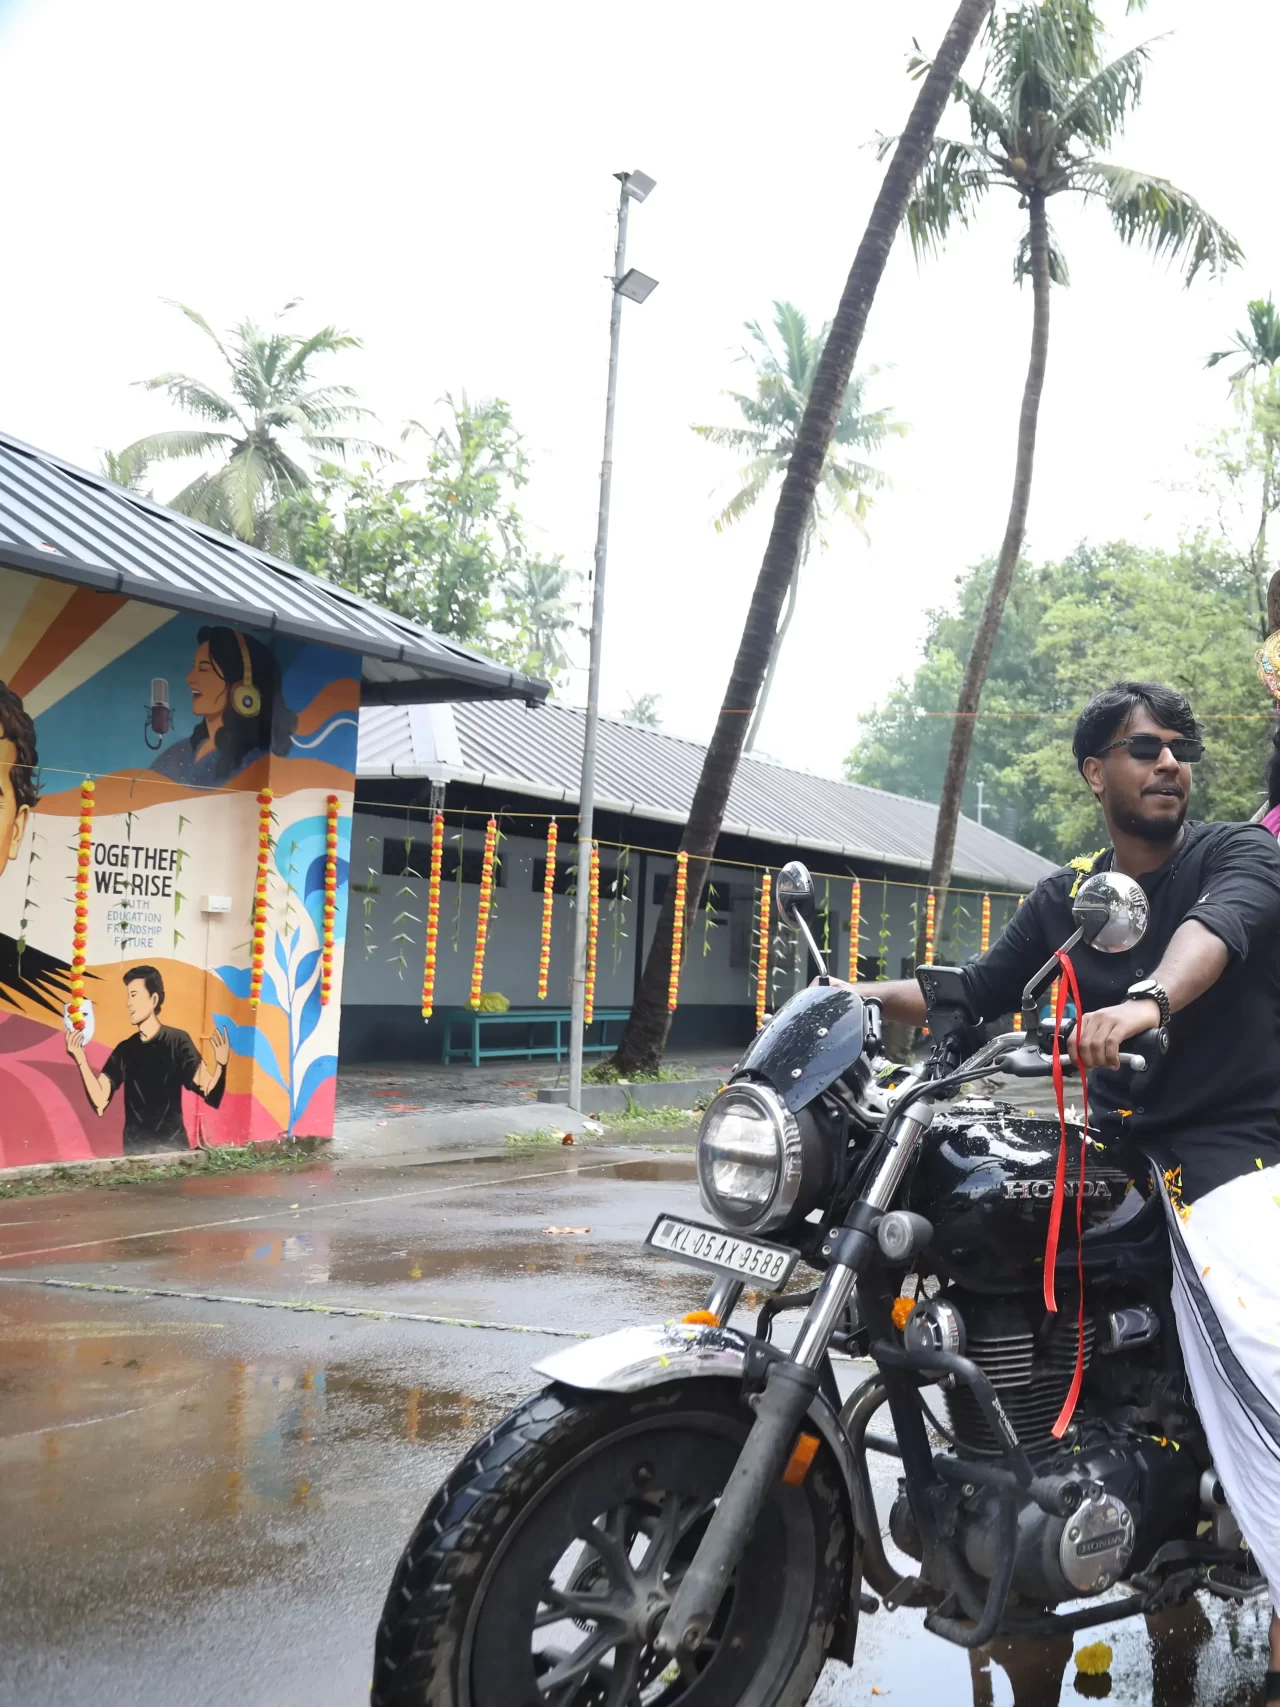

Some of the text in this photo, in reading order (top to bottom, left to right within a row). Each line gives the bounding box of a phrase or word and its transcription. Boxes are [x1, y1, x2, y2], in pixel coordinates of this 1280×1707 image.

[90, 842, 182, 872] OGETHER
[95, 871, 172, 898] WE RISE
[107, 910, 161, 922] EDUCATION
[114, 936, 154, 948] FTURE
[1003, 1180, 1112, 1199] HONDA
[739, 1247, 784, 1277] 9588
